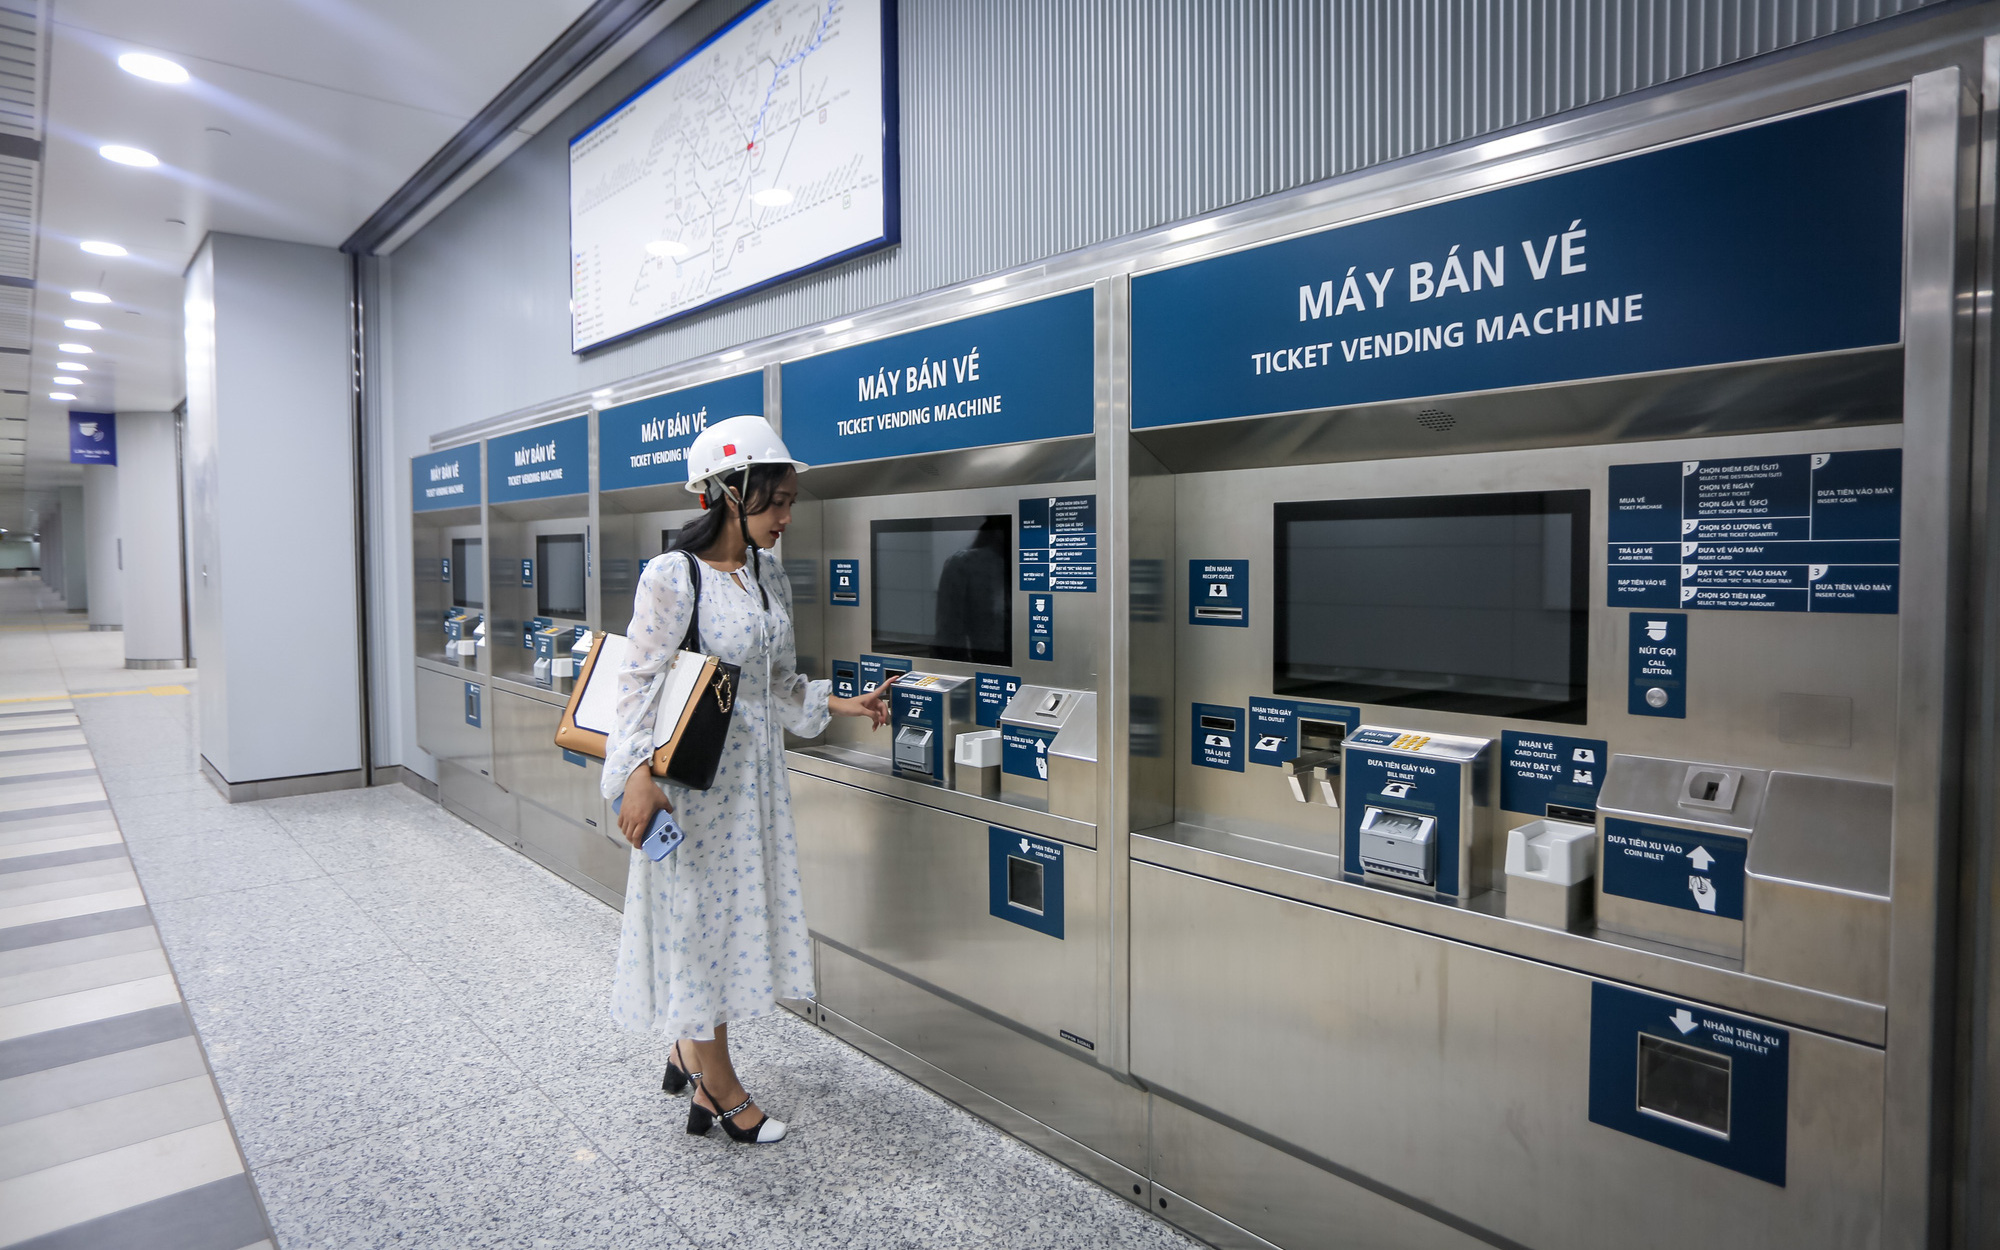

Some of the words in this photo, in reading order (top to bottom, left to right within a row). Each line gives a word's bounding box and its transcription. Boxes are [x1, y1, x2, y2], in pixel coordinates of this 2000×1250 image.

[1300, 268, 1394, 322] MÁY
[1410, 244, 1504, 302] BÁN
[1522, 219, 1586, 280] VÉ
[1252, 342, 1332, 375] TICKET
[1341, 322, 1463, 362] VENDING
[1477, 294, 1642, 344] MACHINE
[859, 367, 900, 402] MÁY
[907, 357, 946, 393] BÁN
[953, 346, 979, 383] VÉ
[642, 418, 665, 443] MÁY
[668, 412, 690, 438] BÁN
[692, 406, 707, 433] VÉ
[837, 416, 874, 436] TICKET
[877, 407, 930, 430] VENDING
[935, 395, 1001, 422] MACHINE
[515, 447, 530, 466] MÁY
[531, 443, 545, 464] BÁN
[546, 440, 555, 460] VÉ
[630, 454, 651, 468] TICKET
[652, 448, 681, 464] VENDING
[508, 475, 521, 486] TICKET
[521, 472, 540, 484] VENDING
[540, 468, 562, 481] MACHINE
[1698, 523, 1719, 531] CHỌN
[1697, 568, 1712, 577] ĐẶT
[1639, 646, 1657, 654] NÚT
[1659, 648, 1676, 656] GỌI
[1215, 750, 1223, 758] LẠI
[1519, 740, 1541, 750] NHẬN
[1543, 742, 1553, 750] VÉ
[1419, 766, 1435, 774] VÀO
[1510, 760, 1531, 768] KHAY
[1533, 763, 1549, 772] ĐẶT
[1608, 835, 1627, 844] ĐƯA
[1649, 842, 1661, 850] XU
[1663, 844, 1682, 854] VÀO
[1624, 848, 1642, 857] COIN
[1644, 852, 1664, 860] INLET
[1703, 1019, 1733, 1035] NHẬN
[1764, 1035, 1779, 1046] XU
[1713, 1034, 1733, 1045] COIN
[1735, 1040, 1768, 1054] OUTLET
